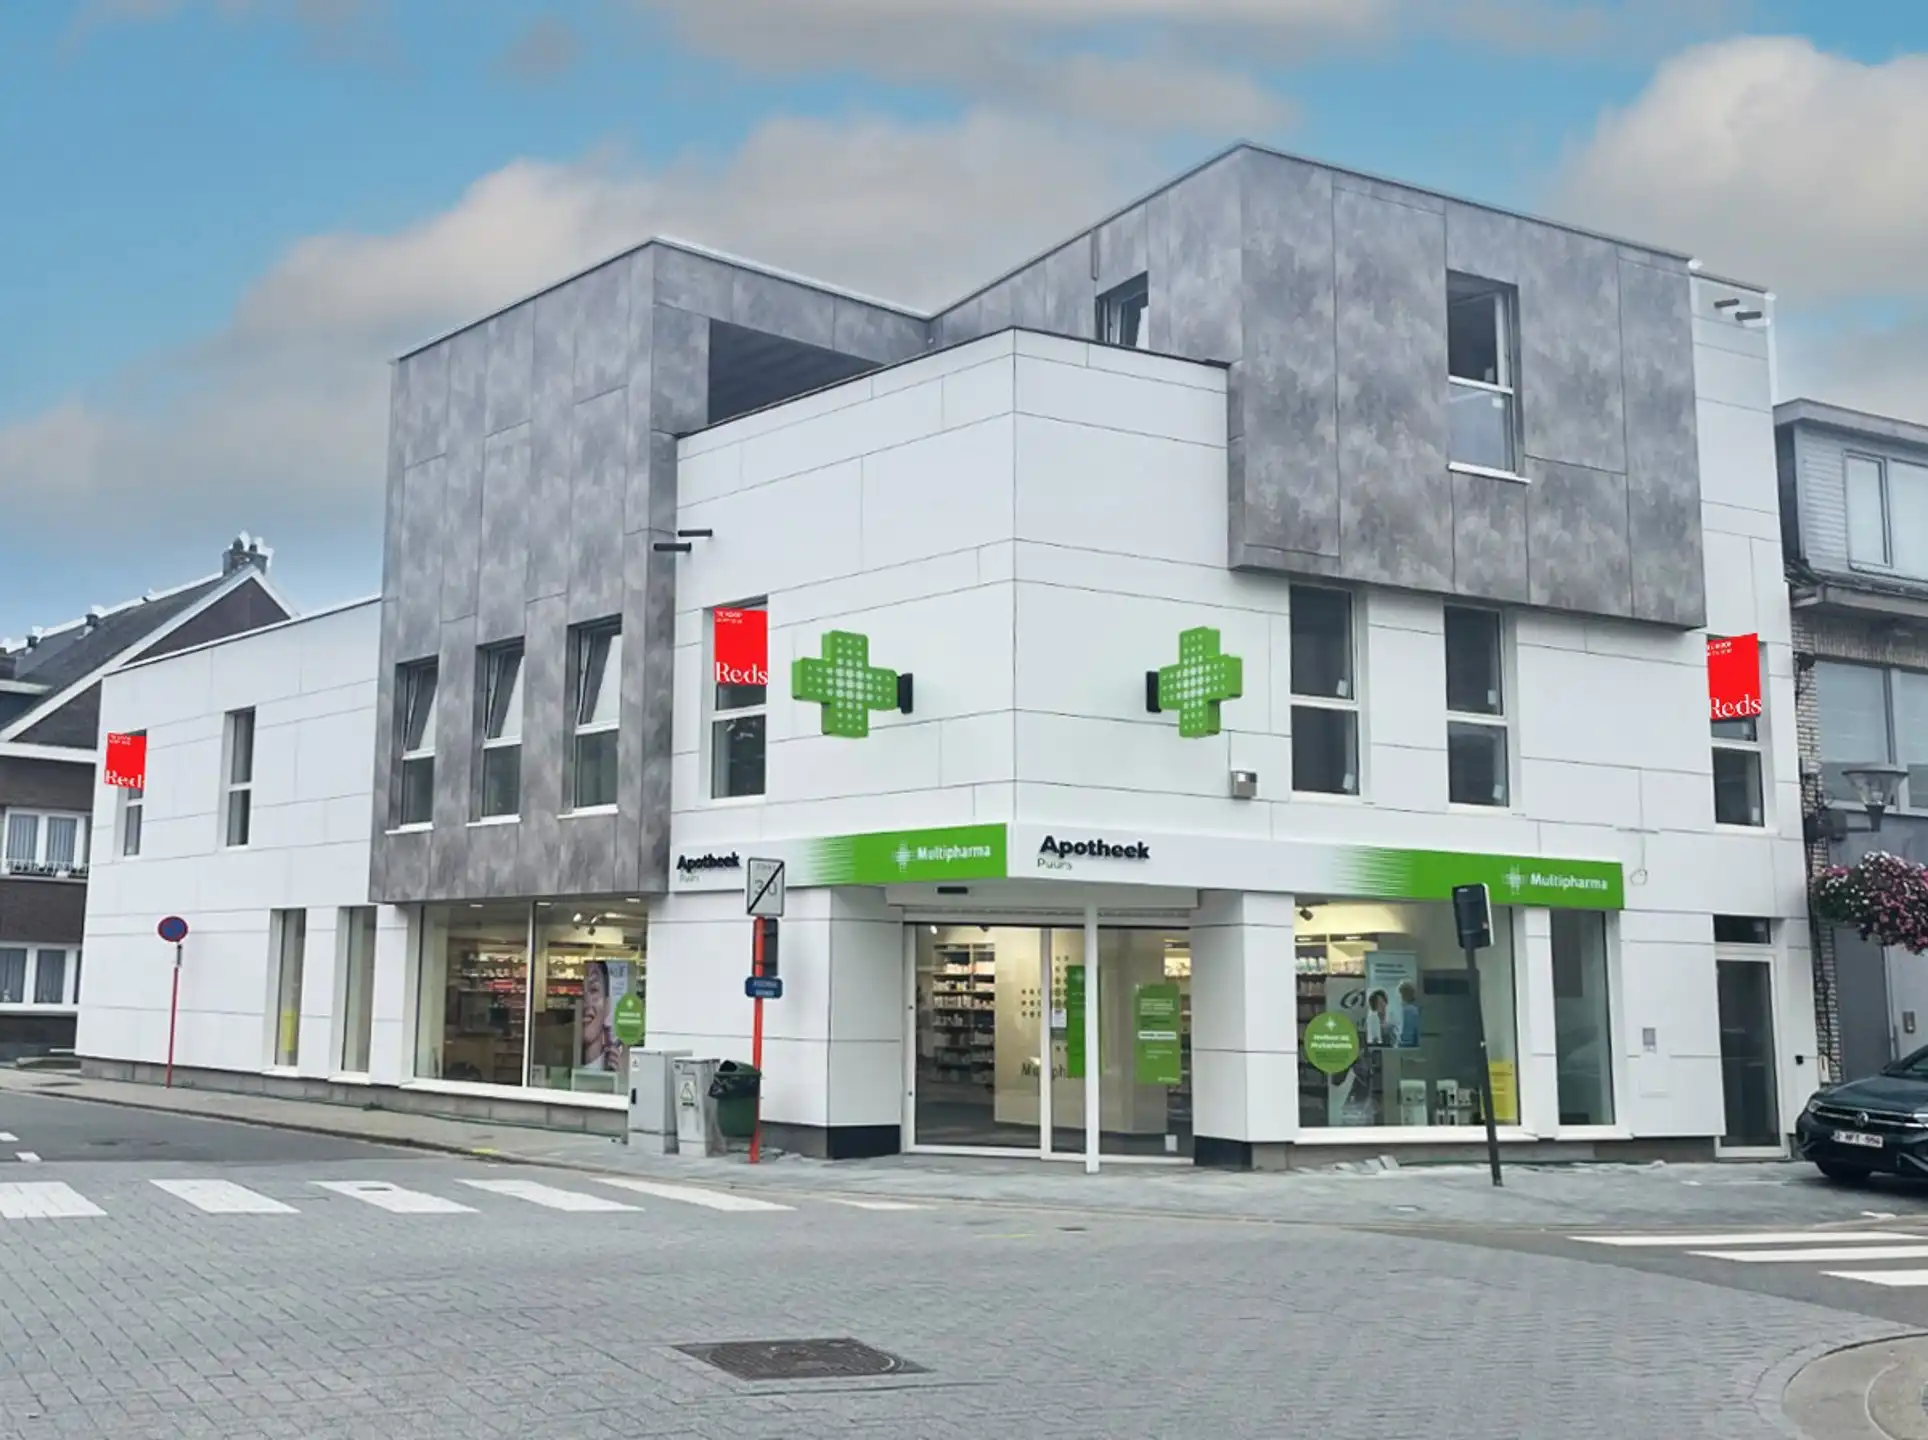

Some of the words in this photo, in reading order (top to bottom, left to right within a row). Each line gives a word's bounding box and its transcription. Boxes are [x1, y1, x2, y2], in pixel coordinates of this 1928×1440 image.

[715, 660, 768, 685] Reds
[1708, 693, 1762, 719] Reds
[916, 845, 991, 864] Multipharma
[1039, 834, 1150, 860] Apotheek
[676, 851, 741, 873] Apotheek
[1037, 857, 1072, 871] Puurs
[754, 878, 778, 897] 30
[1529, 871, 1608, 891] Multipharma
